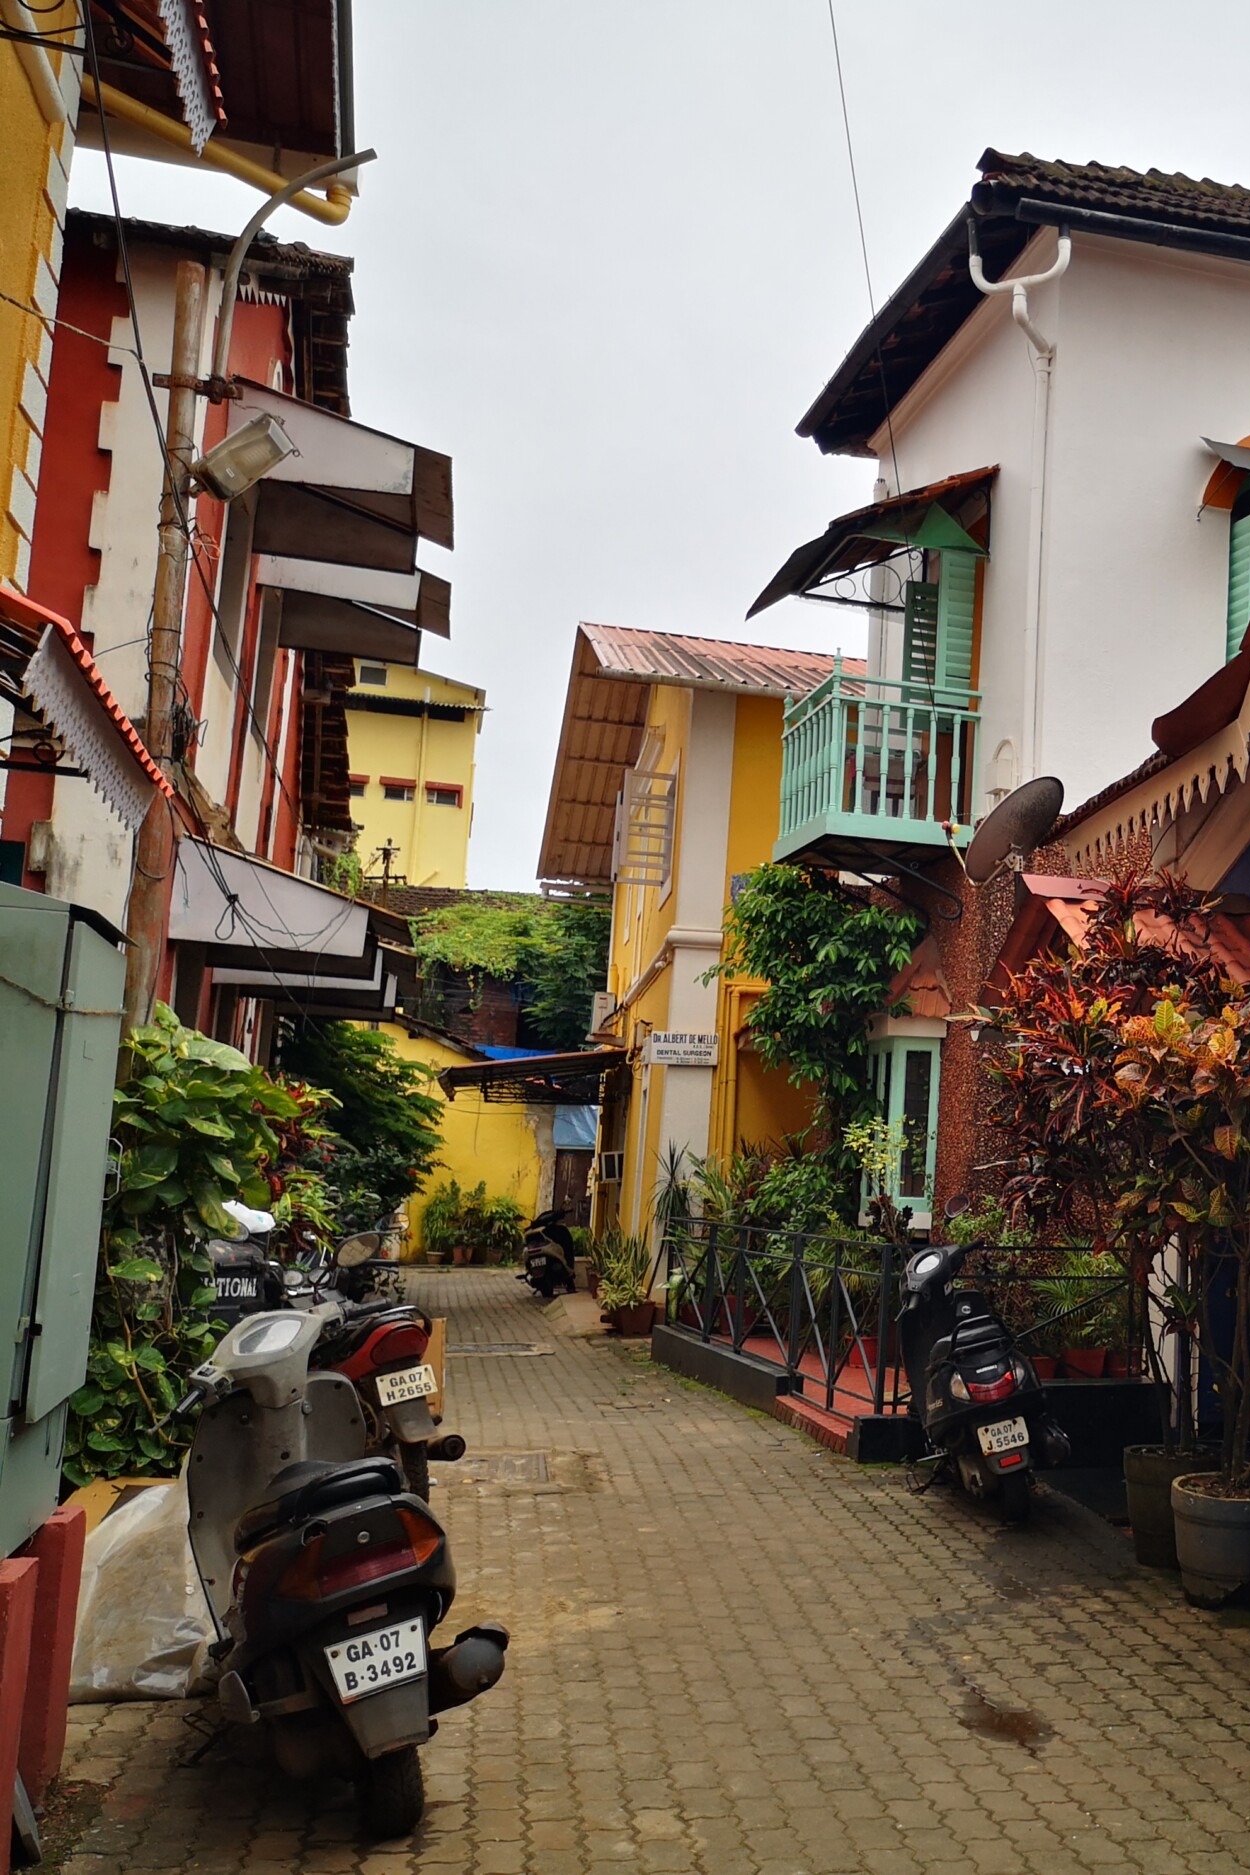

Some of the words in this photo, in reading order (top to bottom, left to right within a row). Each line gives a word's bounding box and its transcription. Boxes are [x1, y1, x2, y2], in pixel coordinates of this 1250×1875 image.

[663, 1033, 687, 1044] ALBERT
[698, 1034, 718, 1045] MELLO
[398, 1382, 432, 1398] 2655
